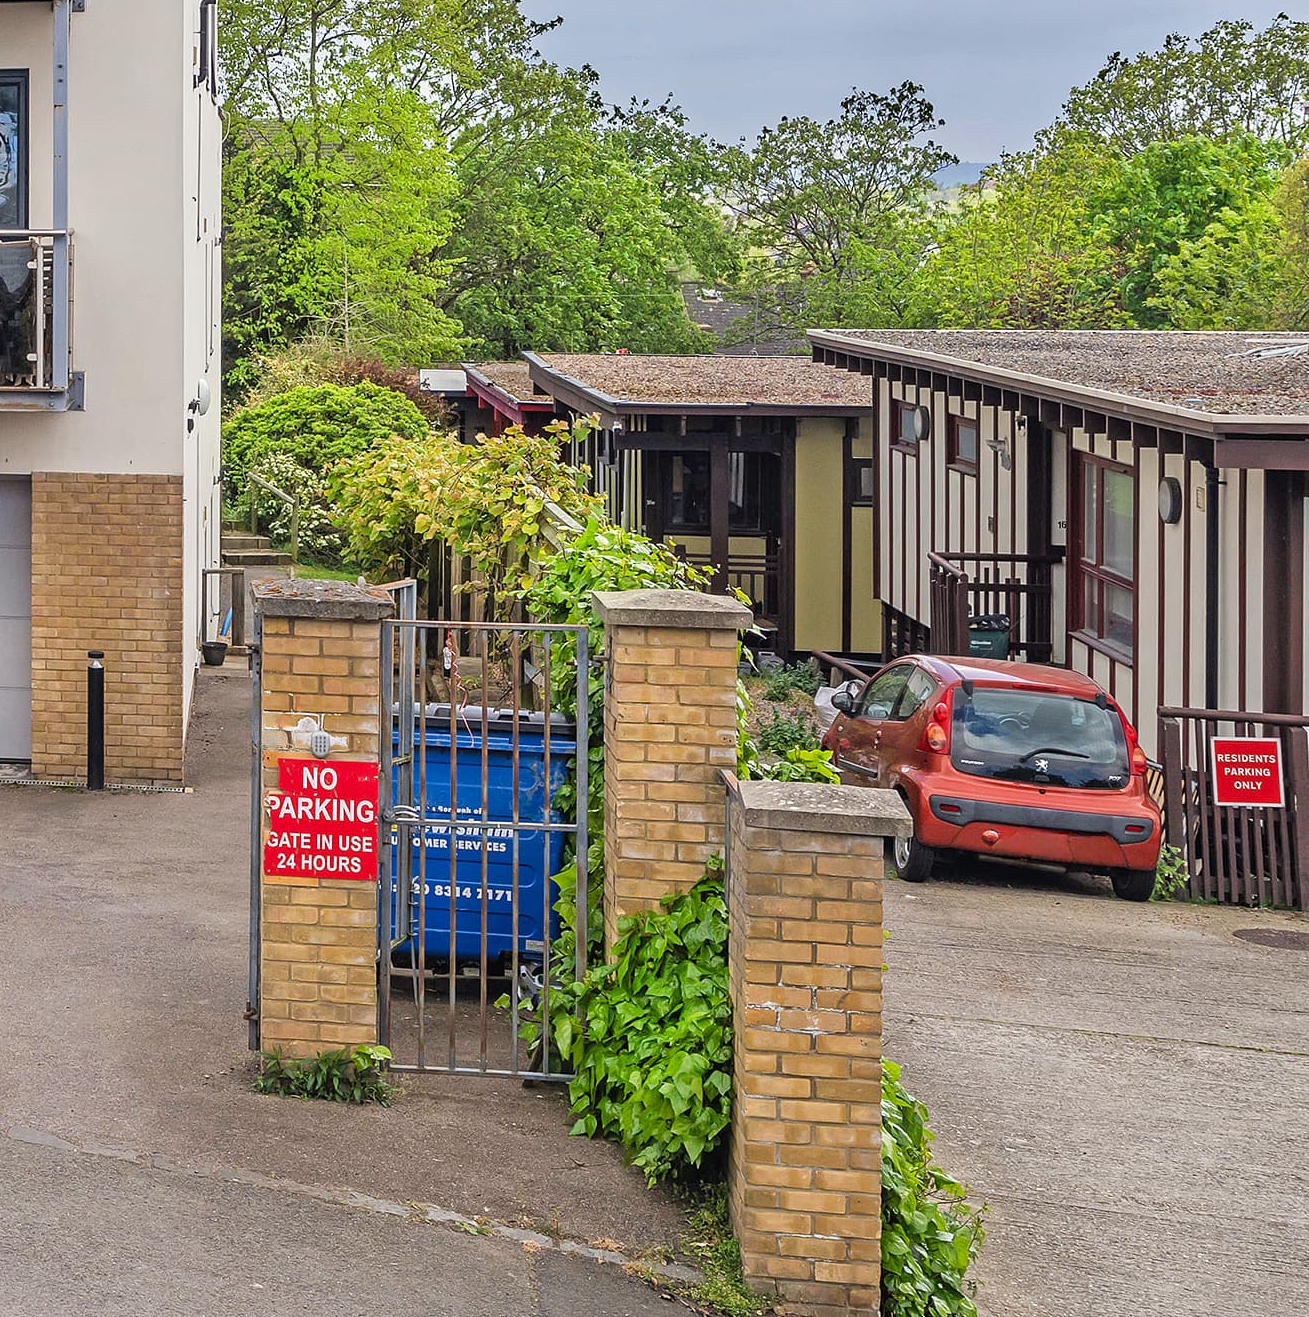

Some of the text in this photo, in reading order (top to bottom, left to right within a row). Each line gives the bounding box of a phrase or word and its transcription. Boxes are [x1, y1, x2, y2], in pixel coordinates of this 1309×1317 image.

[1217, 753, 1276, 763] RESIDENTS
[302, 766, 338, 790] NO
[1224, 767, 1271, 777] PARKING
[1234, 780, 1262, 790] ONLY
[265, 795, 374, 823] PARKING
[267, 831, 373, 852] GATE IN USE
[276, 853, 361, 873] 24 HOURS
